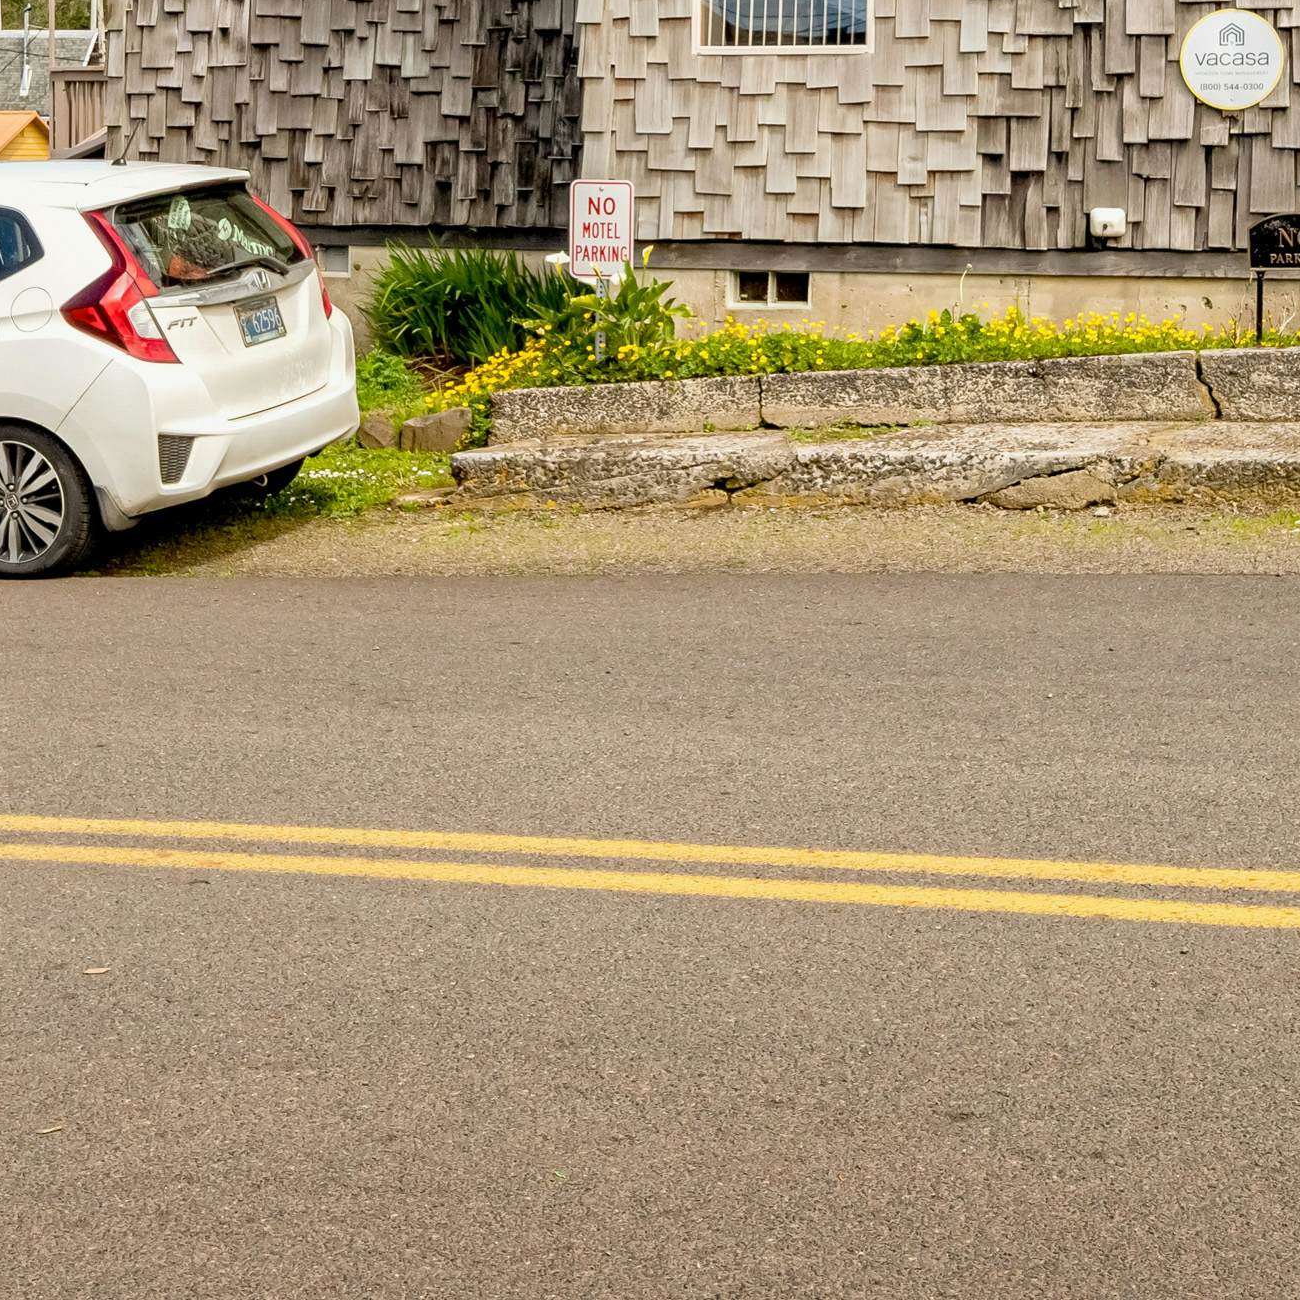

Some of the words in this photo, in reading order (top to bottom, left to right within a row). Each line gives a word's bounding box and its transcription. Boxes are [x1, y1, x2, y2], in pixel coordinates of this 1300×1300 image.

[1194, 52, 1269, 67] vacasa
[1200, 83, 1221, 92] (800)
[1224, 83, 1264, 91] 544-0300
[588, 197, 616, 216] NO
[582, 222, 620, 239] MOTEL
[575, 245, 628, 262] PARKING
[167, 316, 197, 330] FIT
